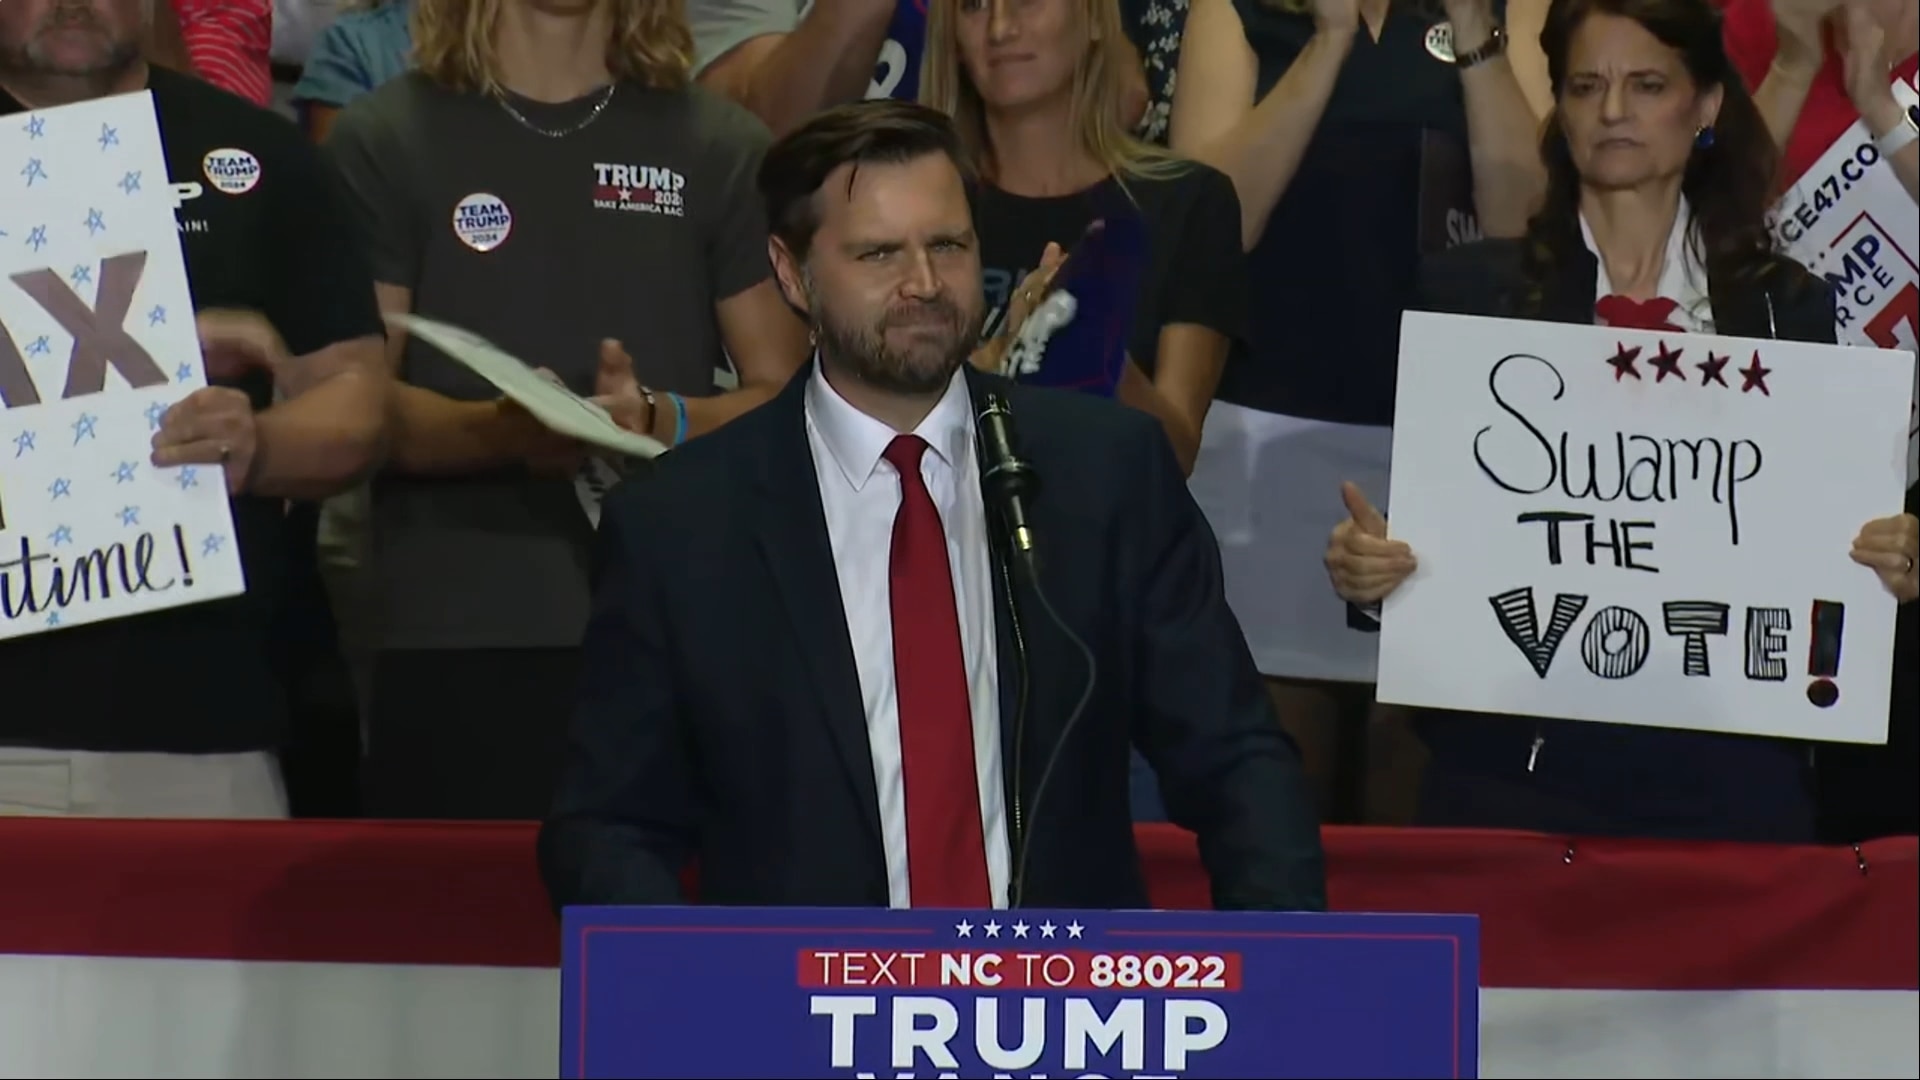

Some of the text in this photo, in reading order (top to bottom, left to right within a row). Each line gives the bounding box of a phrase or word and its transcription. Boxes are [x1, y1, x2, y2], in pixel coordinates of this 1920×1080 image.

[207, 165, 257, 176] TRUMP
[208, 157, 252, 167] TEAM
[593, 162, 685, 192] TRUMP
[1780, 132, 1879, 242] CE47.CO
[457, 215, 509, 229] TRUMP
[460, 204, 503, 217] TEAM
[663, 207, 684, 217] BAC
[1473, 353, 1762, 545] Swamp
[1517, 511, 1660, 573] THE
[1488, 586, 1844, 708] VOTE!
[815, 952, 1226, 988] TEXT NC TO 88022
[810, 995, 1229, 1071] TRUMP
